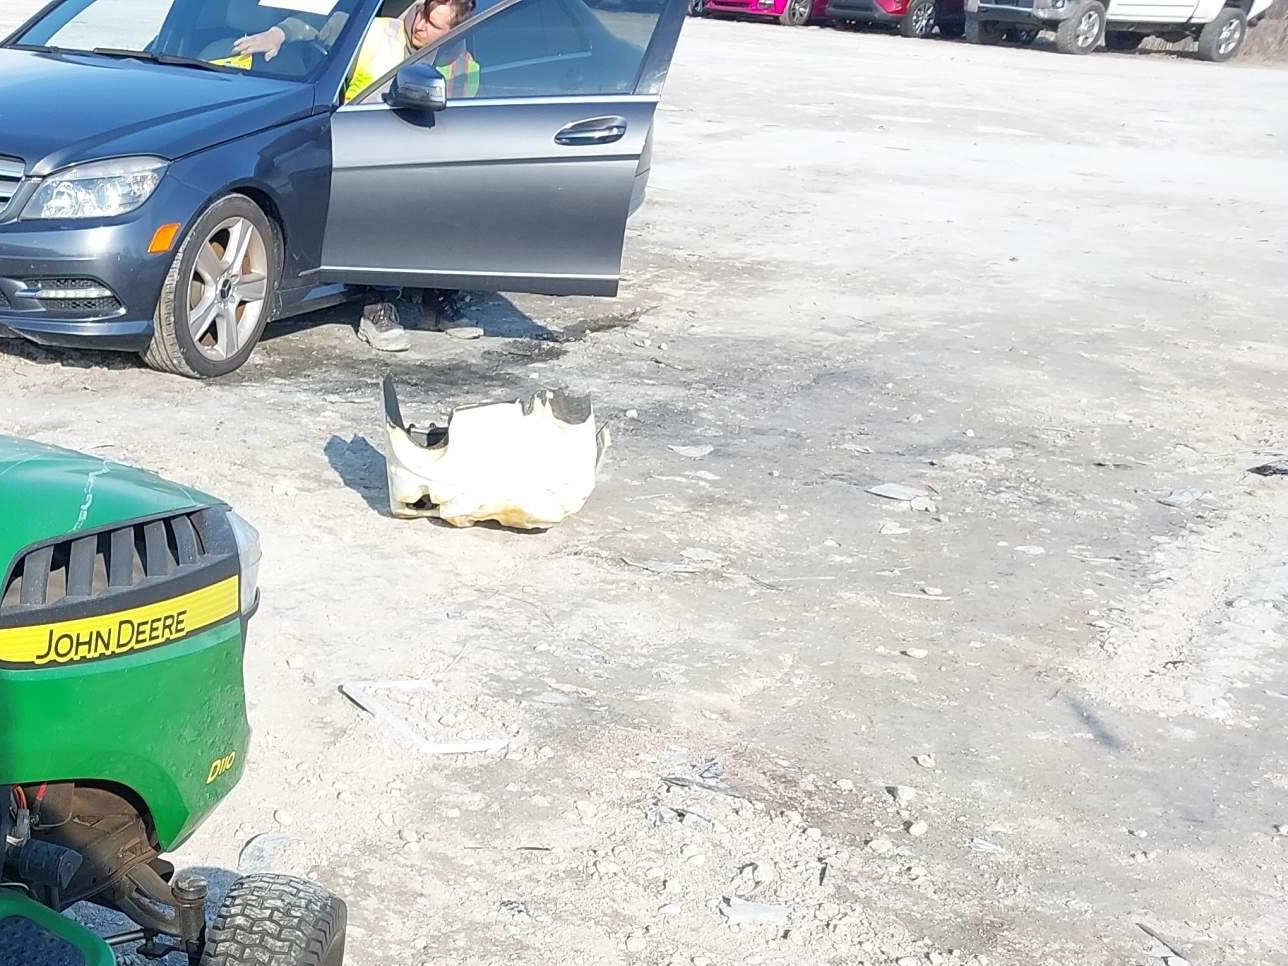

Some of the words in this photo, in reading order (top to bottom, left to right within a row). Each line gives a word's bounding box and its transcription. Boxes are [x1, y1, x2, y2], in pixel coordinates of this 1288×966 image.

[35, 628, 112, 660] JOHN
[116, 609, 188, 650] DEERE
[206, 751, 236, 785] D110
